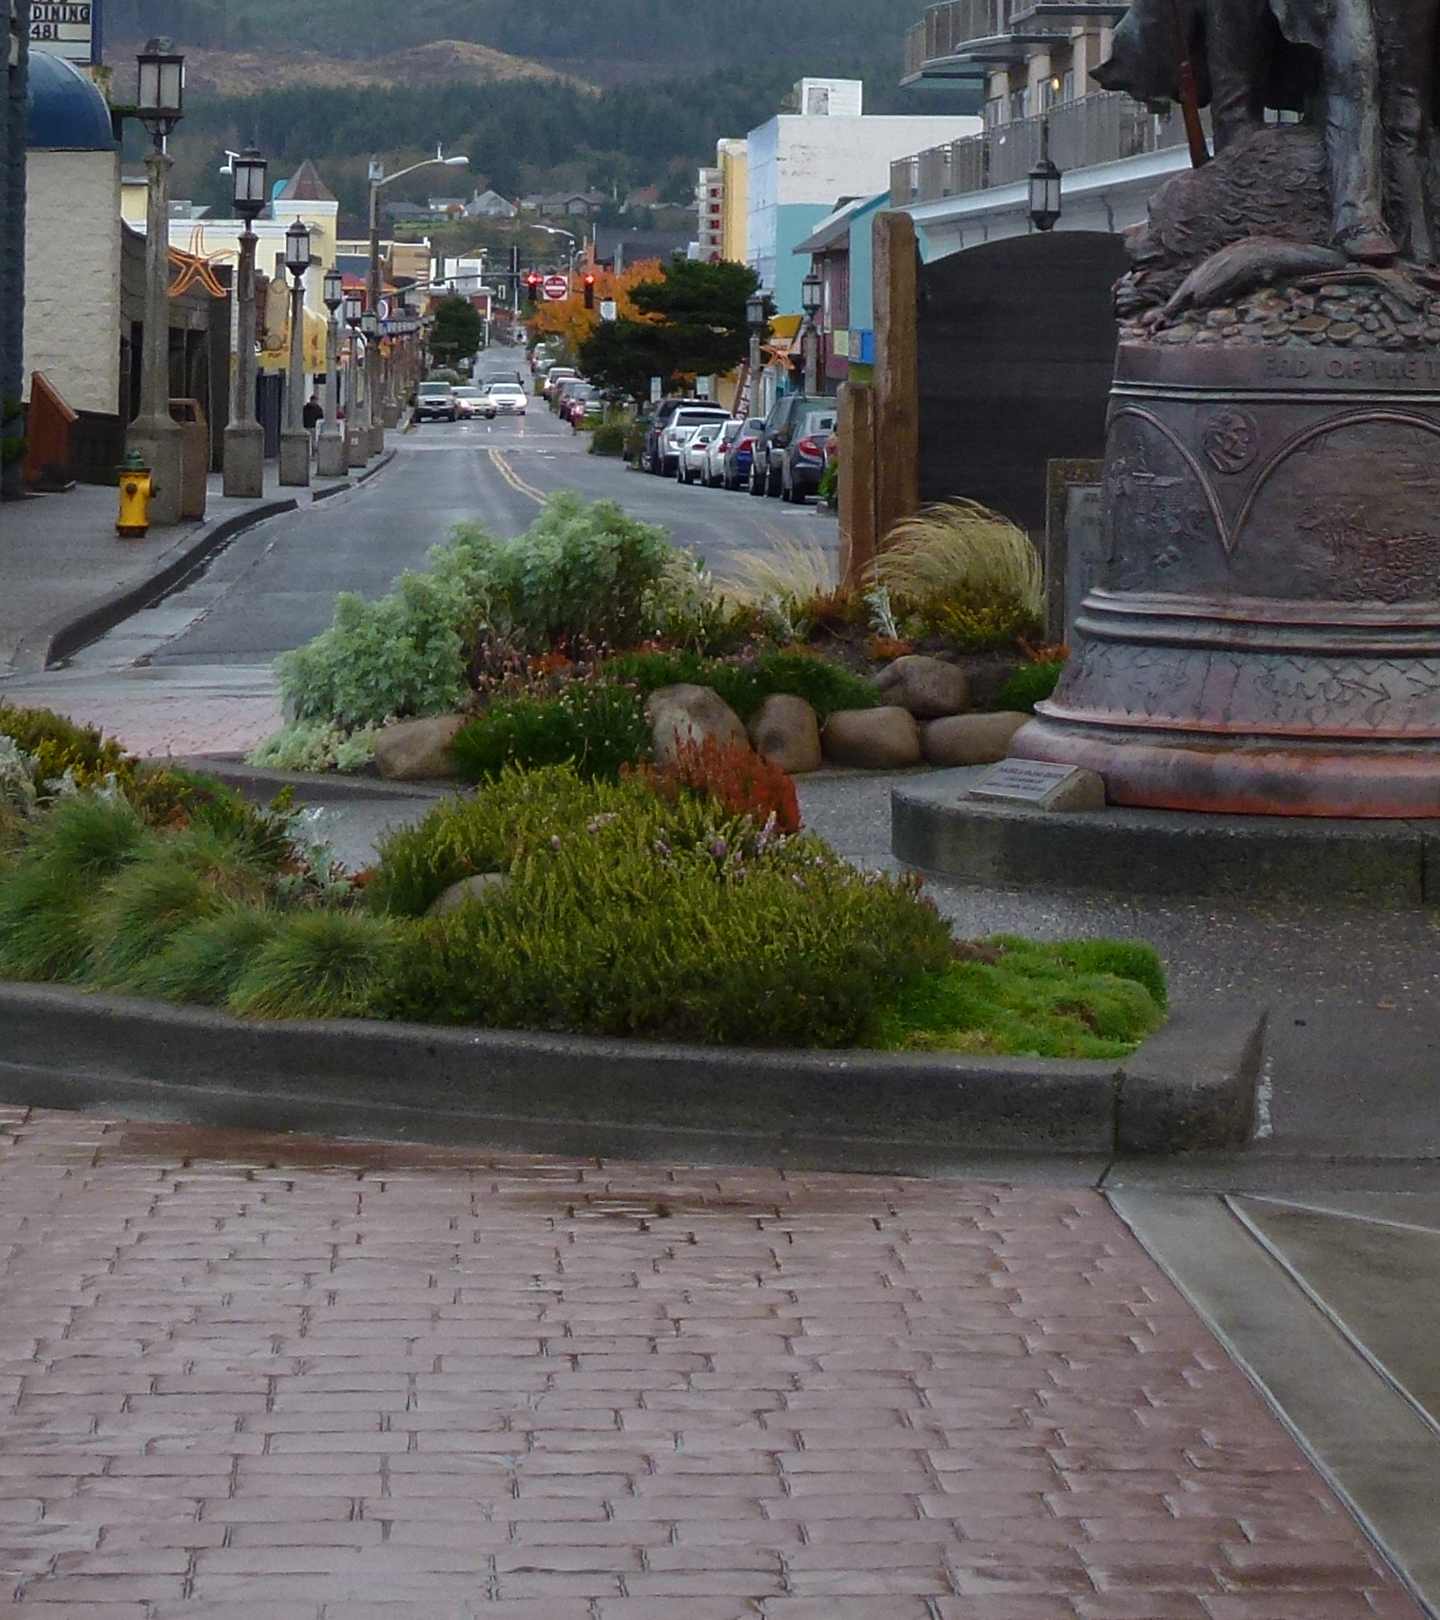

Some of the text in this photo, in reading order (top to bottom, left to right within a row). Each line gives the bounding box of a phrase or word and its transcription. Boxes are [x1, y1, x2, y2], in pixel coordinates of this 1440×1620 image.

[33, 5, 91, 21] DINING
[1323, 358, 1362, 379] OF
[1367, 359, 1418, 380] THE
